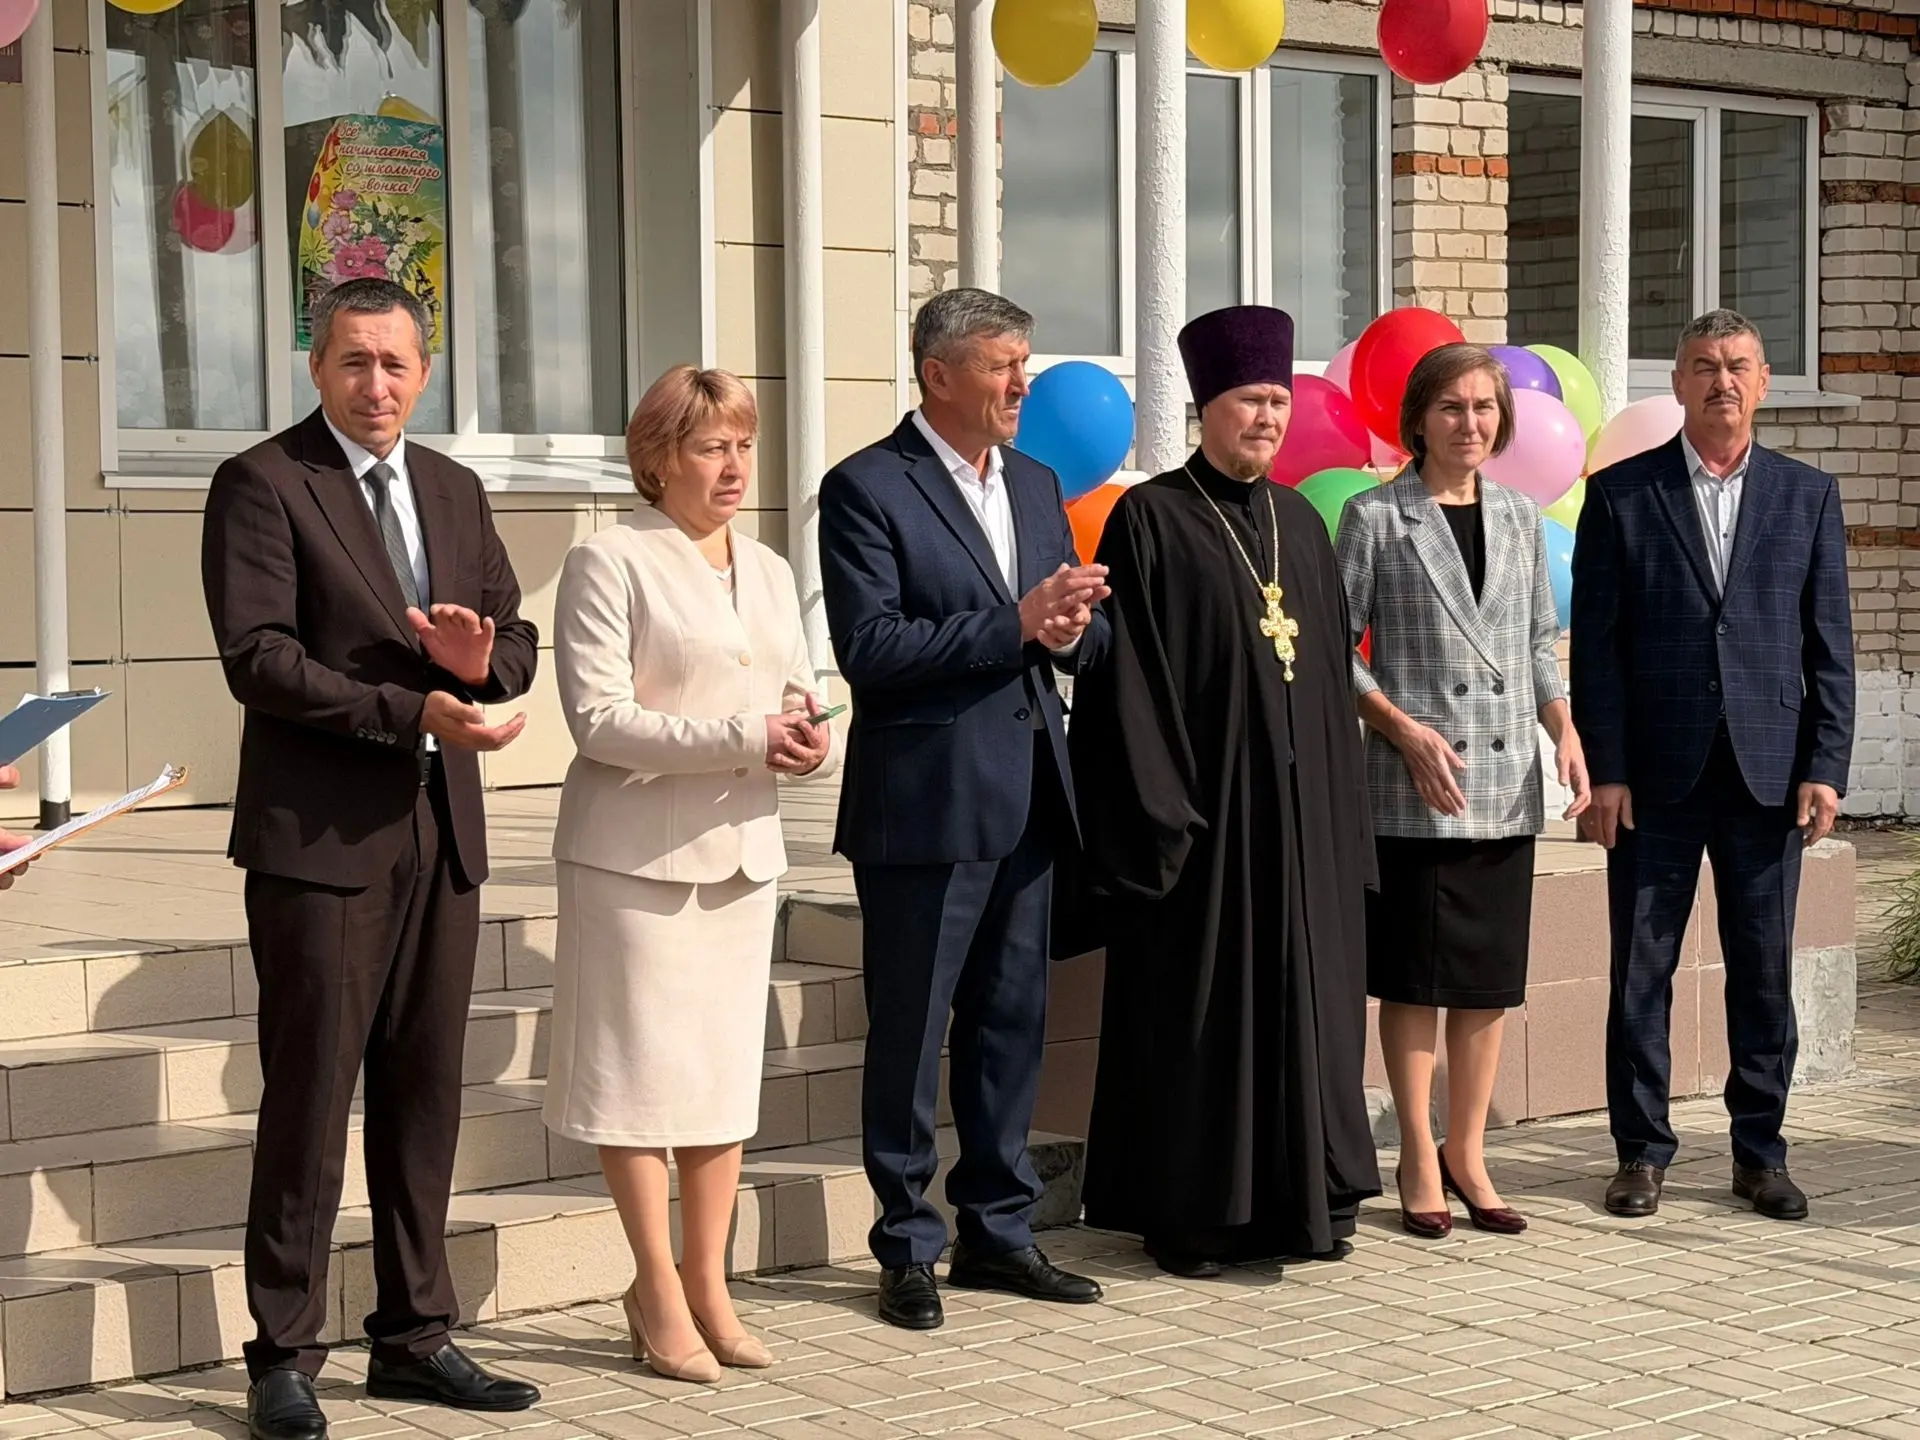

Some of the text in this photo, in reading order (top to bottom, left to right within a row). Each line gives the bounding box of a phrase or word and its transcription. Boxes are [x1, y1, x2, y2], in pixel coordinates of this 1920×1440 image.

[339, 145, 428, 160] начинается
[346, 162, 441, 179] со школьного
[360, 177, 420, 193] звонка!
